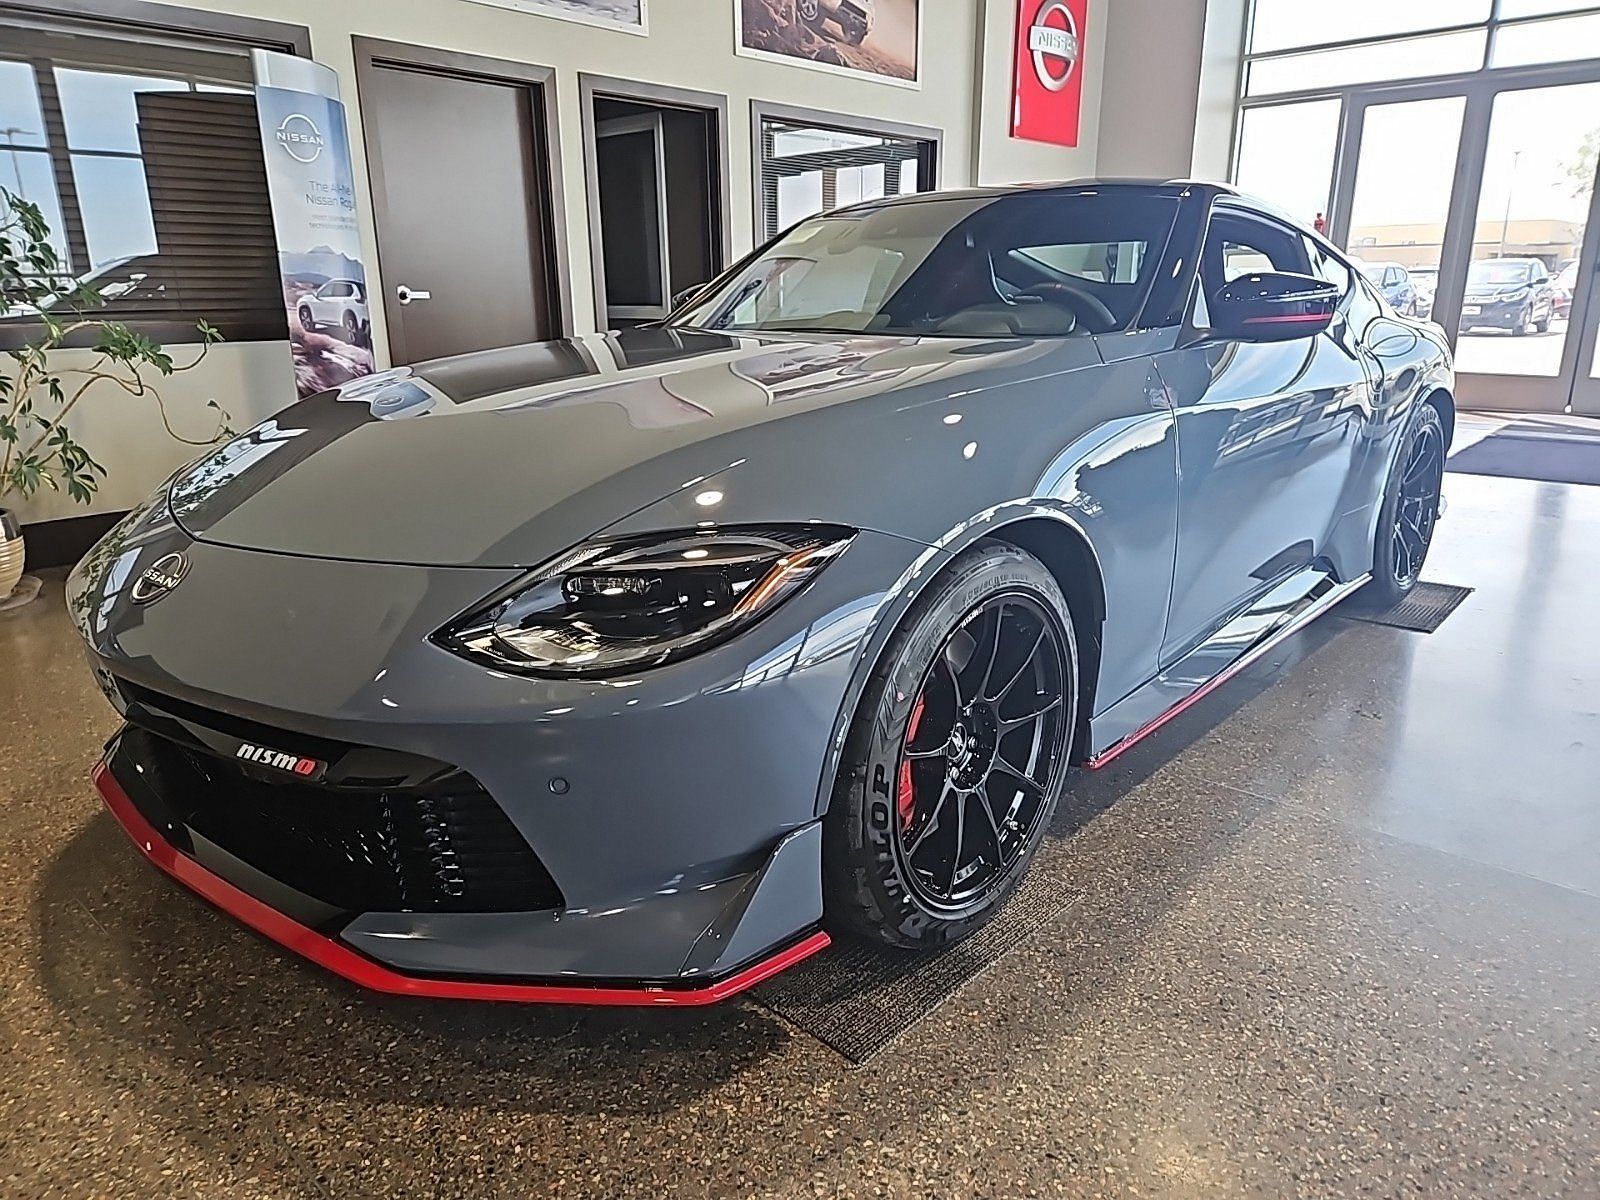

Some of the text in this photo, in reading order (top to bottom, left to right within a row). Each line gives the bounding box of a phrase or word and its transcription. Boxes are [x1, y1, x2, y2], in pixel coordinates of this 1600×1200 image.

[276, 131, 324, 145] NISSAN
[308, 180, 329, 193] The
[305, 193, 338, 206] Nissan
[236, 743, 316, 775] nismo
